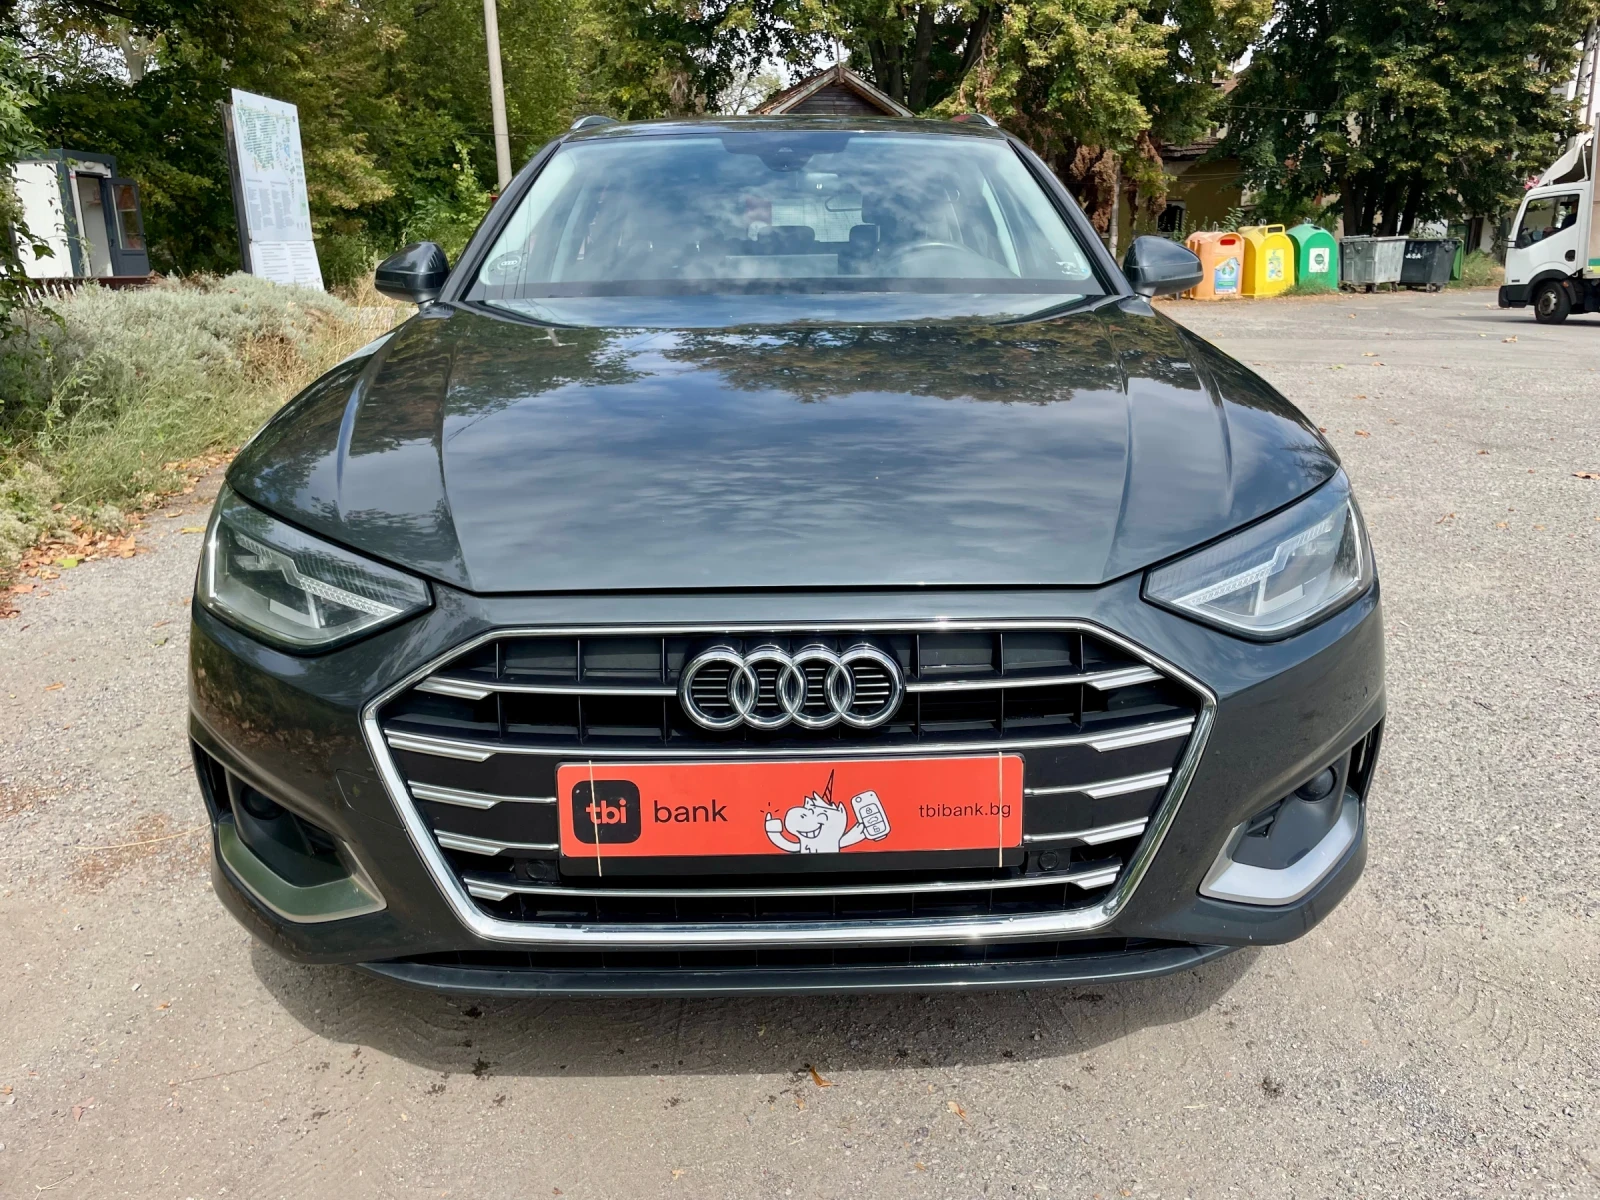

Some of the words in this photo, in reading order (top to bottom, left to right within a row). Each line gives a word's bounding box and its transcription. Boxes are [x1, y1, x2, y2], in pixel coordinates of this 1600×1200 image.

[586, 799, 627, 825] tbi
[653, 799, 729, 824] bank
[918, 802, 1011, 819] tbibank.bg
